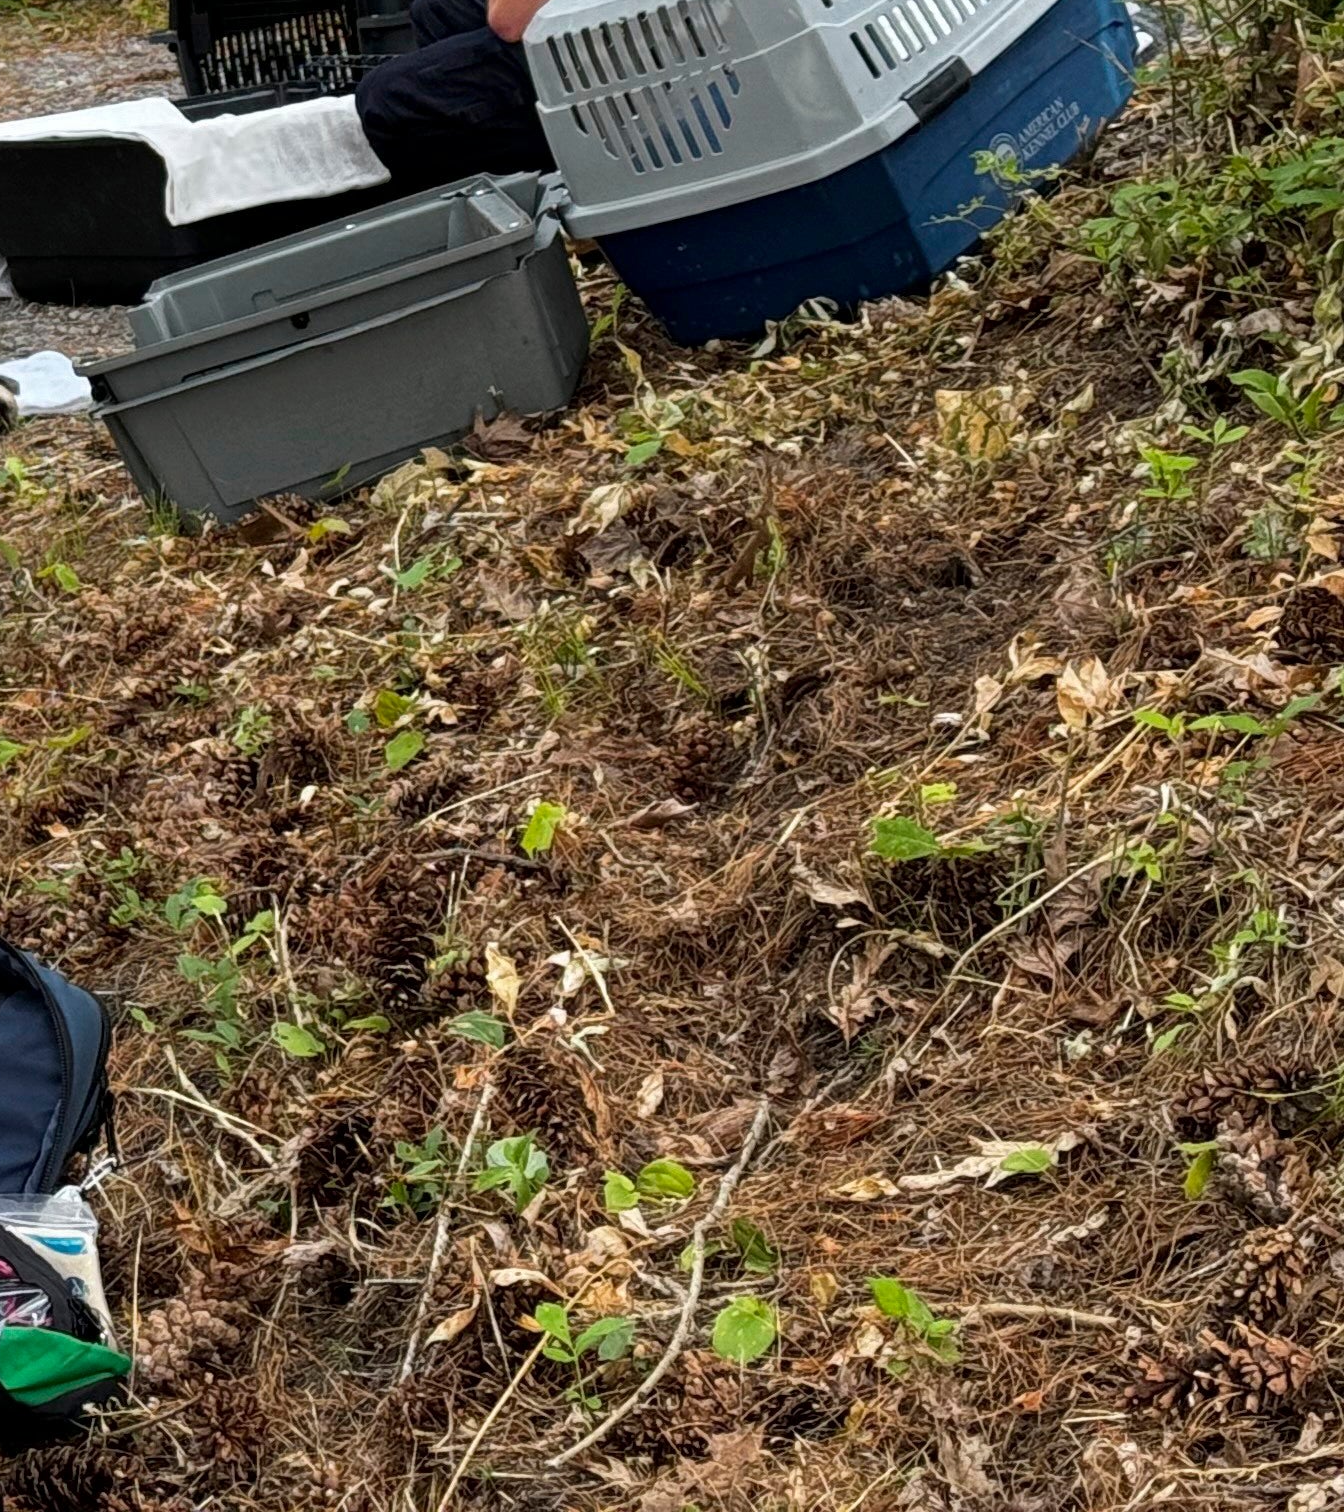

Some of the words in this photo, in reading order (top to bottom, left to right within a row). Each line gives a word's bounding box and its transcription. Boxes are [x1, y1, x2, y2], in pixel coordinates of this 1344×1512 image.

[1017, 98, 1064, 146] AMERICAN
[1021, 121, 1060, 161] KENNEL
[1056, 101, 1080, 129] CLUB
